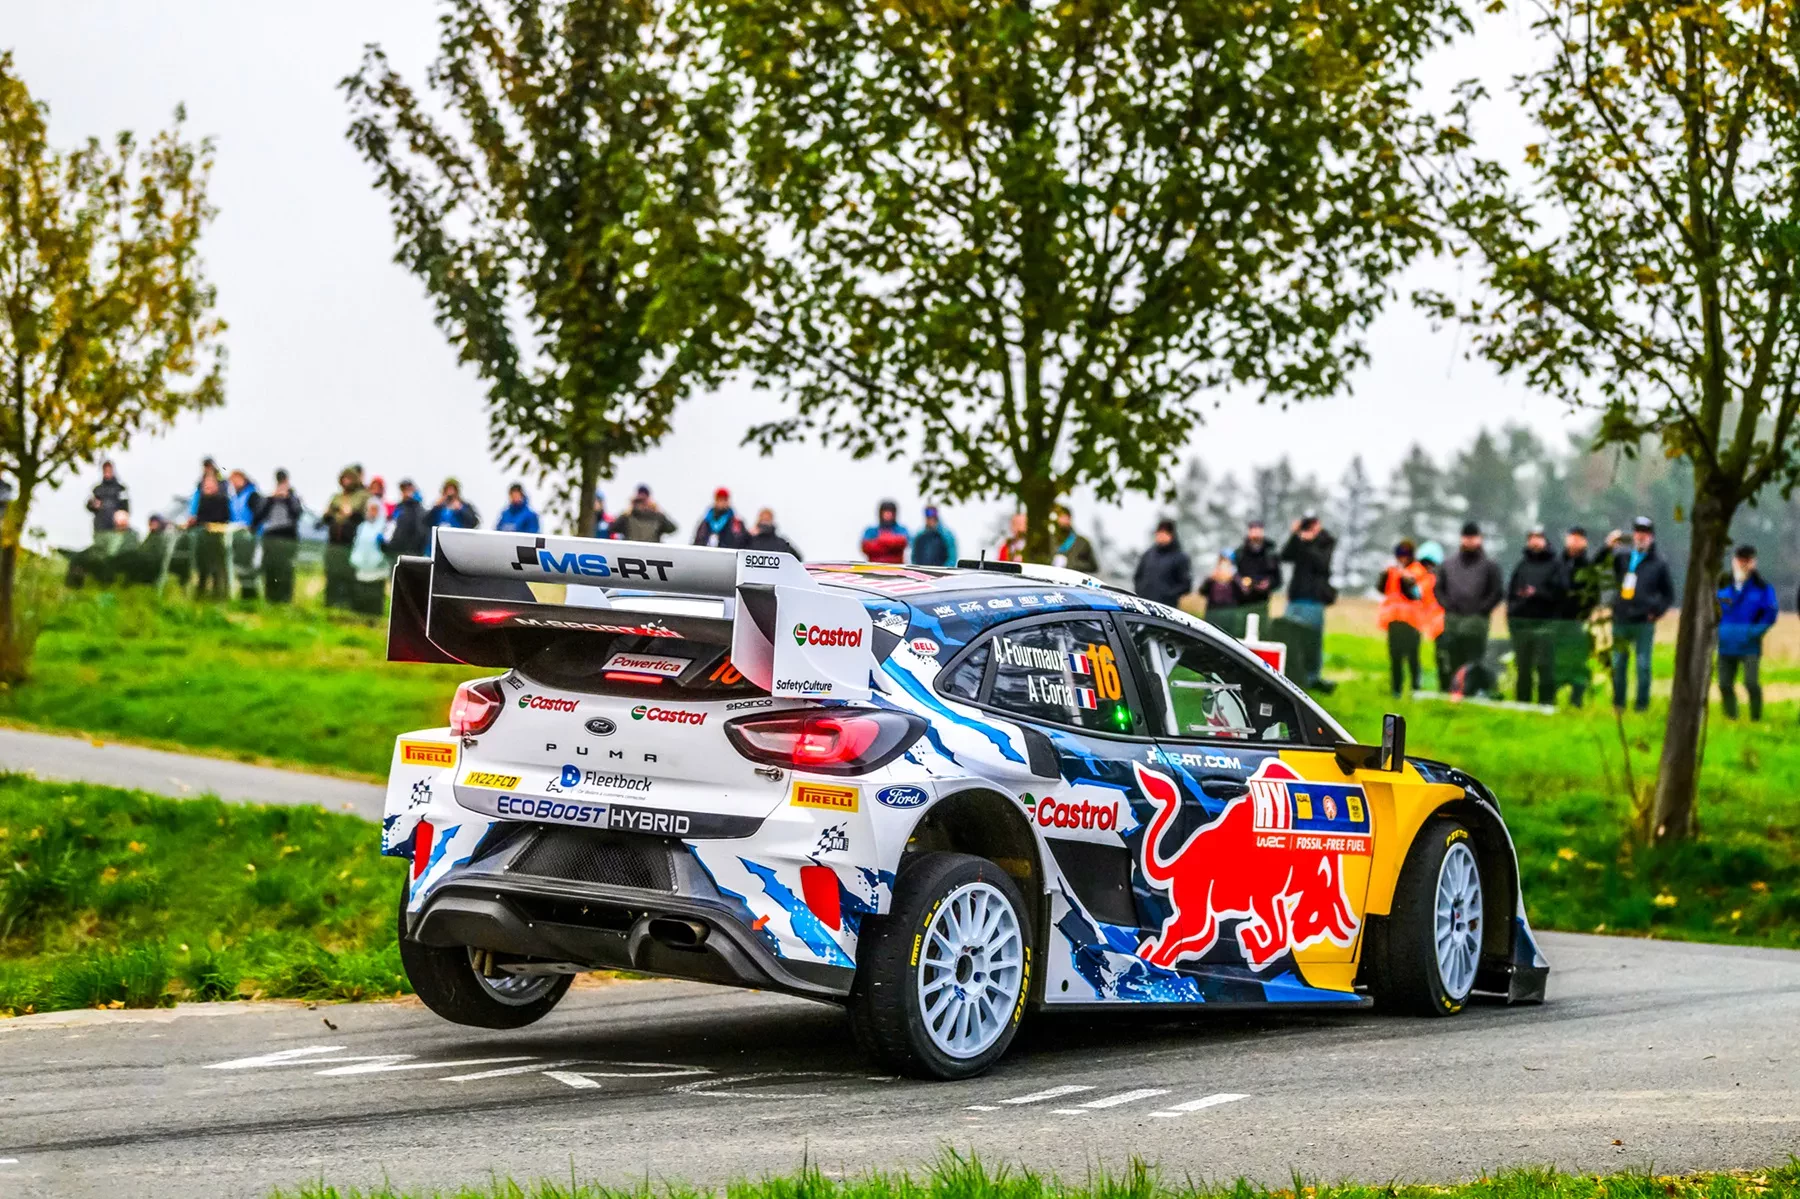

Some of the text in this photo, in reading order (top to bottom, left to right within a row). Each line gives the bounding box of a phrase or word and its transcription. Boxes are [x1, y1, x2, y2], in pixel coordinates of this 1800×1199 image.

[538, 550, 673, 581] MS-RT
[745, 554, 780, 568] sparco
[808, 625, 863, 647] Castrol
[913, 642, 936, 651] BELL
[992, 635, 1067, 672] A Fourmaux
[612, 656, 681, 672] Powertica
[1087, 643, 1121, 700] 16
[776, 679, 832, 693] SafetyCulture
[1027, 674, 1074, 707] A Coria
[530, 695, 580, 712] Castrol
[725, 698, 773, 710] sparco
[647, 707, 708, 725] Castrol
[406, 746, 452, 763] PIRELLI
[546, 743, 658, 763] PUMA
[469, 772, 518, 788] YX22 FCD
[584, 771, 652, 792] Fleetback
[797, 786, 853, 807] PIRELLI
[886, 788, 920, 805] Ford
[1251, 781, 1286, 828] HY
[497, 795, 690, 835] ECOBOOST HYBRID
[1037, 796, 1119, 831] Castrol
[1256, 836, 1366, 852] WRC FOSSIL-FREE FUEL
